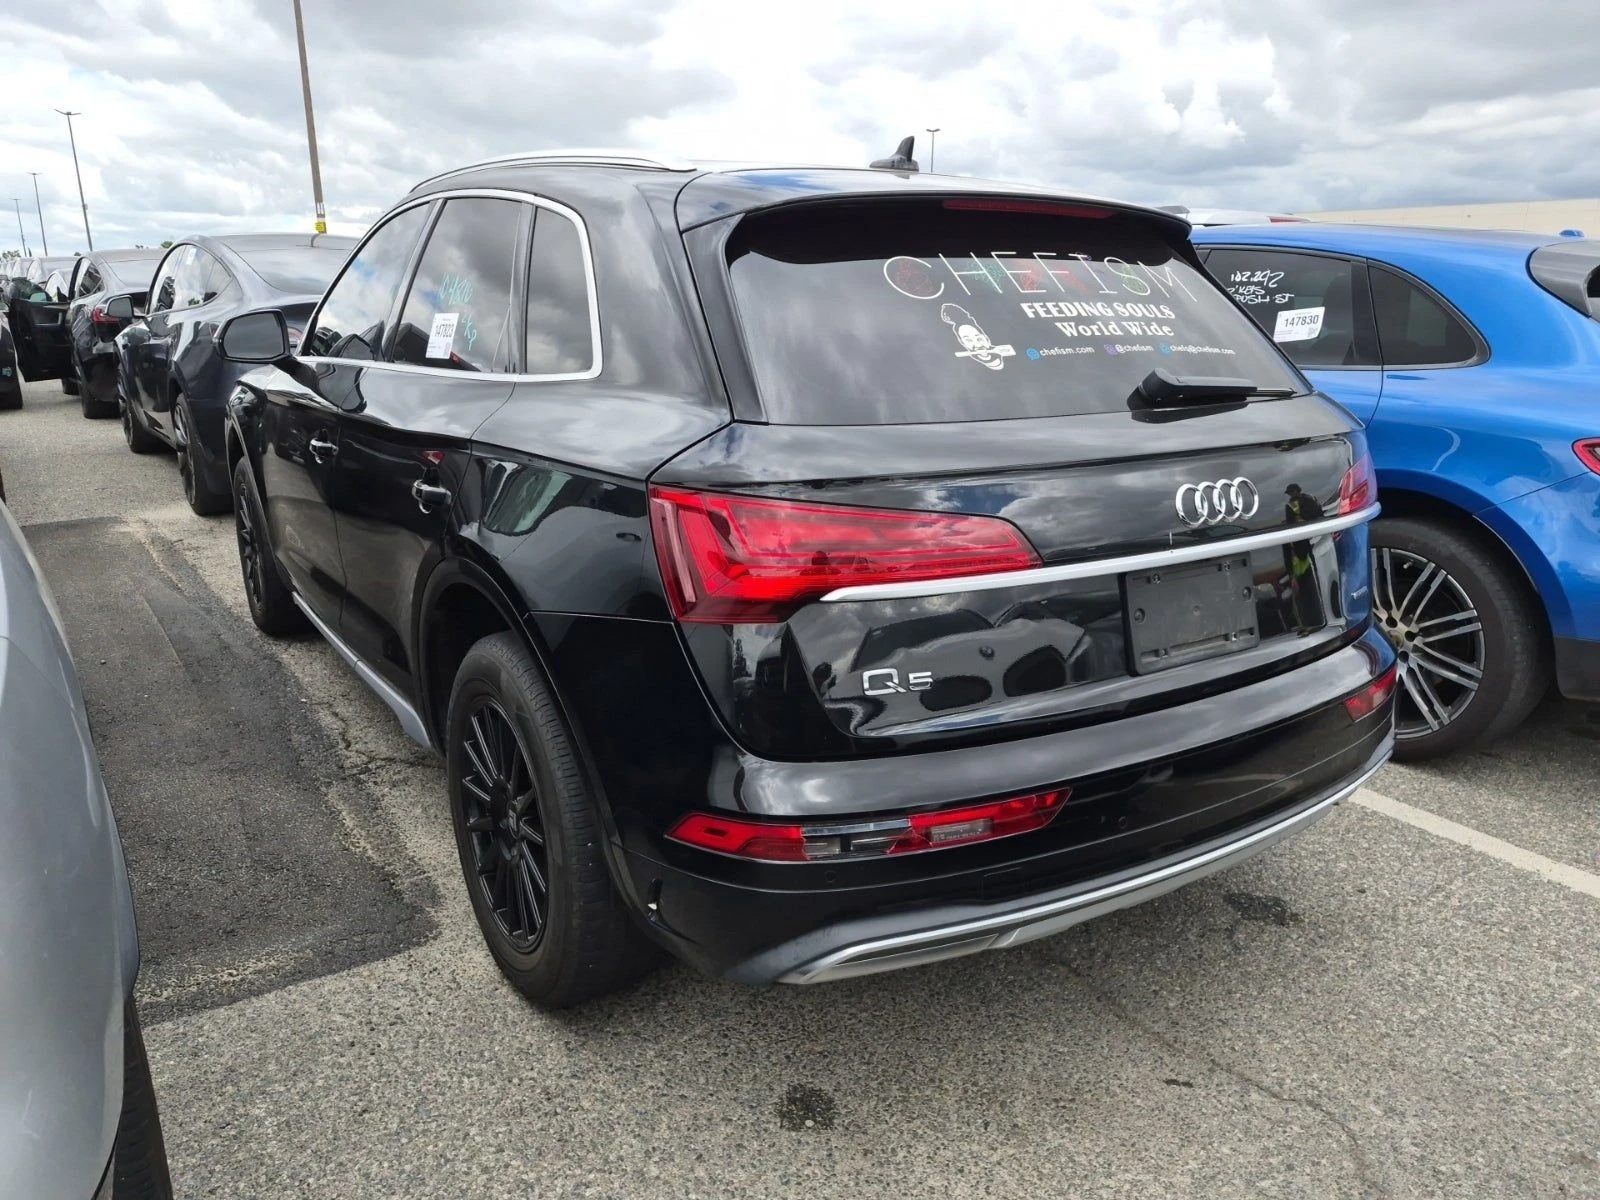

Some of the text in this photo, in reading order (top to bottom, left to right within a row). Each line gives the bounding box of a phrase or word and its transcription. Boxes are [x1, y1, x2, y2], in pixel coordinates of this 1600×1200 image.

[884, 251, 1198, 303] CHEFISM
[1020, 301, 1176, 320] FEEDING SOULS
[1055, 321, 1175, 337] World Wide
[1284, 314, 1320, 328] 147830
[1039, 346, 1095, 357] chefism.com
[862, 668, 933, 696] Q5
